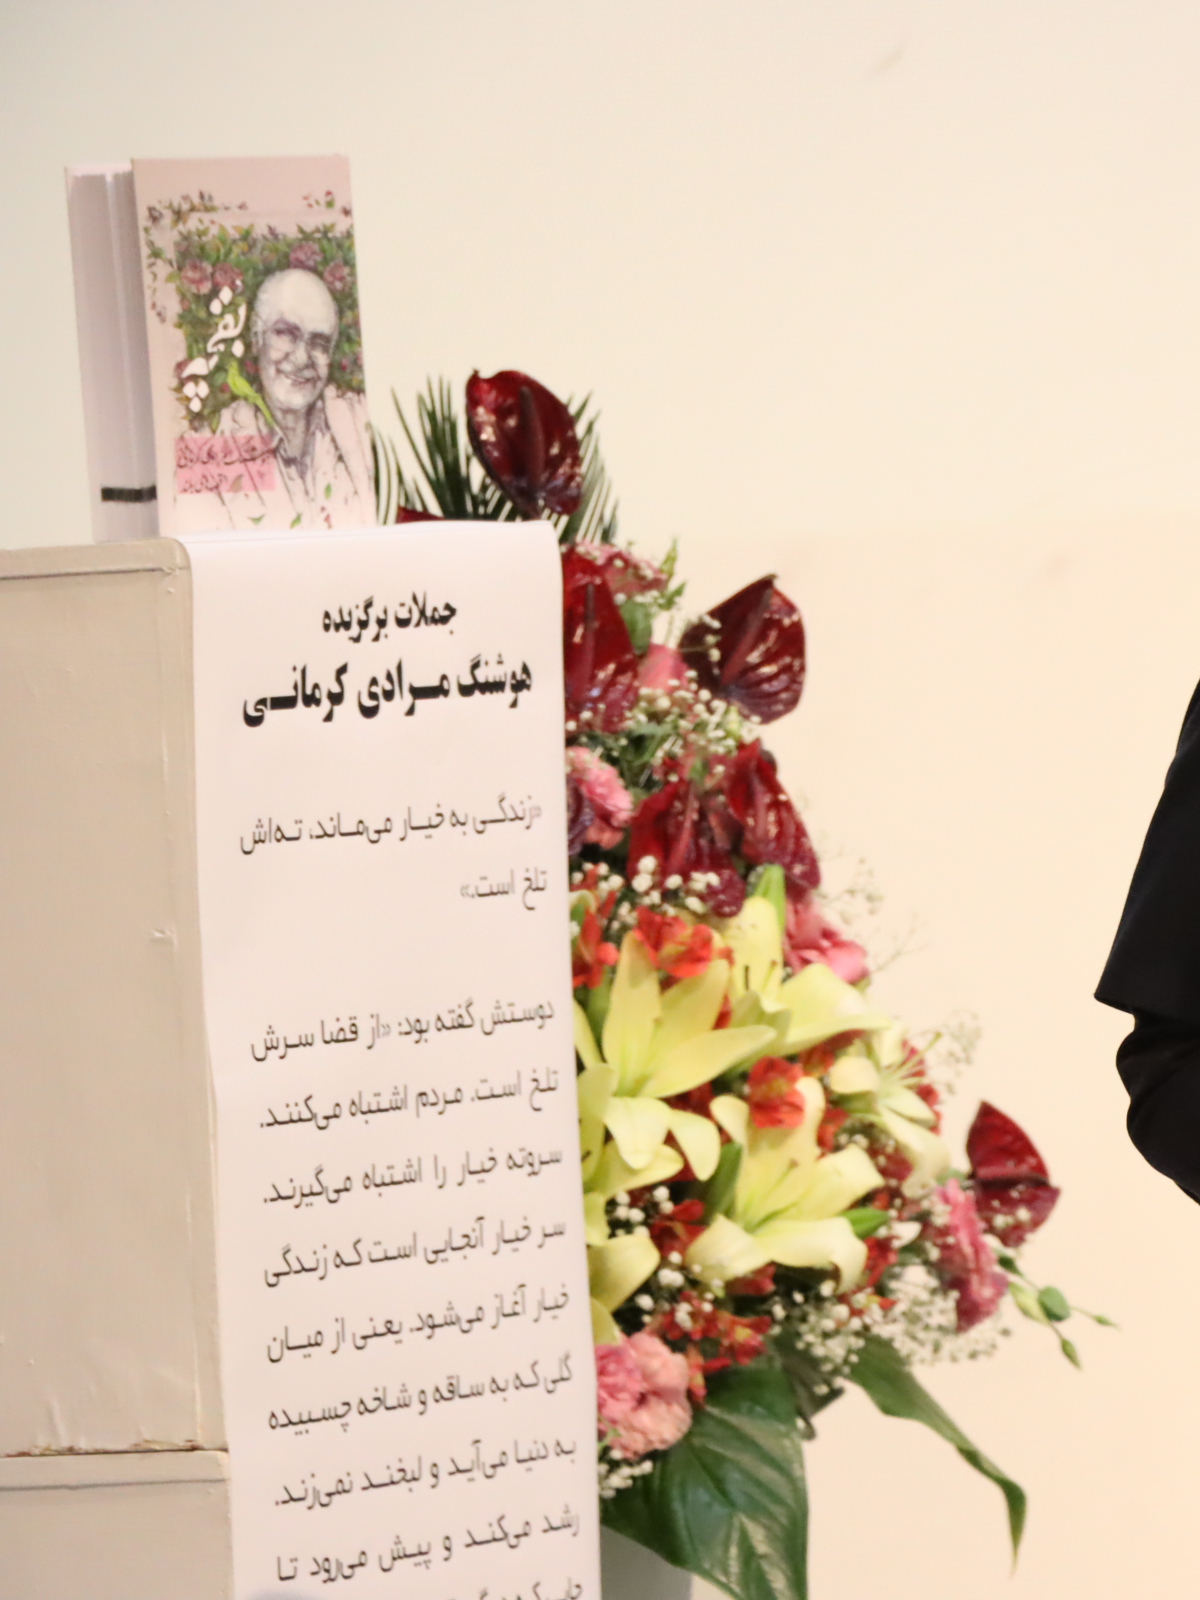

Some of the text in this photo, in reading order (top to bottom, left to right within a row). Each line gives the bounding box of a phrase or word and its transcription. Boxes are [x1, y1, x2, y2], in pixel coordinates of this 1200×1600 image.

[322, 591, 457, 644] جملات برگزیده
[242, 653, 533, 728] هوشنگ مرادی کرمانی
[399, 803, 445, 842] خیار
[450, 810, 468, 836] به
[522, 868, 547, 911] تلخ
[321, 1016, 359, 1045] قضا
[398, 1017, 430, 1044] بود:
[435, 998, 475, 1032] گفته
[481, 1000, 554, 1036] دوستش
[251, 1025, 314, 1062] سرش
[349, 1085, 408, 1124] اشتباه
[416, 1087, 463, 1118] مردم
[471, 1071, 521, 1102] است.
[529, 1068, 558, 1112] تلخ
[362, 1157, 422, 1197] اشتباه
[434, 1155, 446, 1189] را
[457, 1148, 498, 1187] خیار
[264, 1216, 565, 1288] سر خیار آنجایی است که زندگی
[491, 1283, 526, 1330] آغاز
[533, 1284, 569, 1323] خیار
[267, 1326, 324, 1364] میان
[330, 1317, 345, 1355] از
[352, 1317, 403, 1351] یعنی
[268, 1353, 572, 1436] گلی که به ساقه و شاخه چسبیده
[514, 1440, 549, 1472] دنیا
[554, 1440, 575, 1463] به
[361, 1456, 422, 1492] لبخند
[430, 1462, 440, 1489] و
[542, 1505, 578, 1537] رشد
[378, 1535, 431, 1573] پیش
[443, 1535, 452, 1562] و
[277, 1556, 298, 1582] تا
